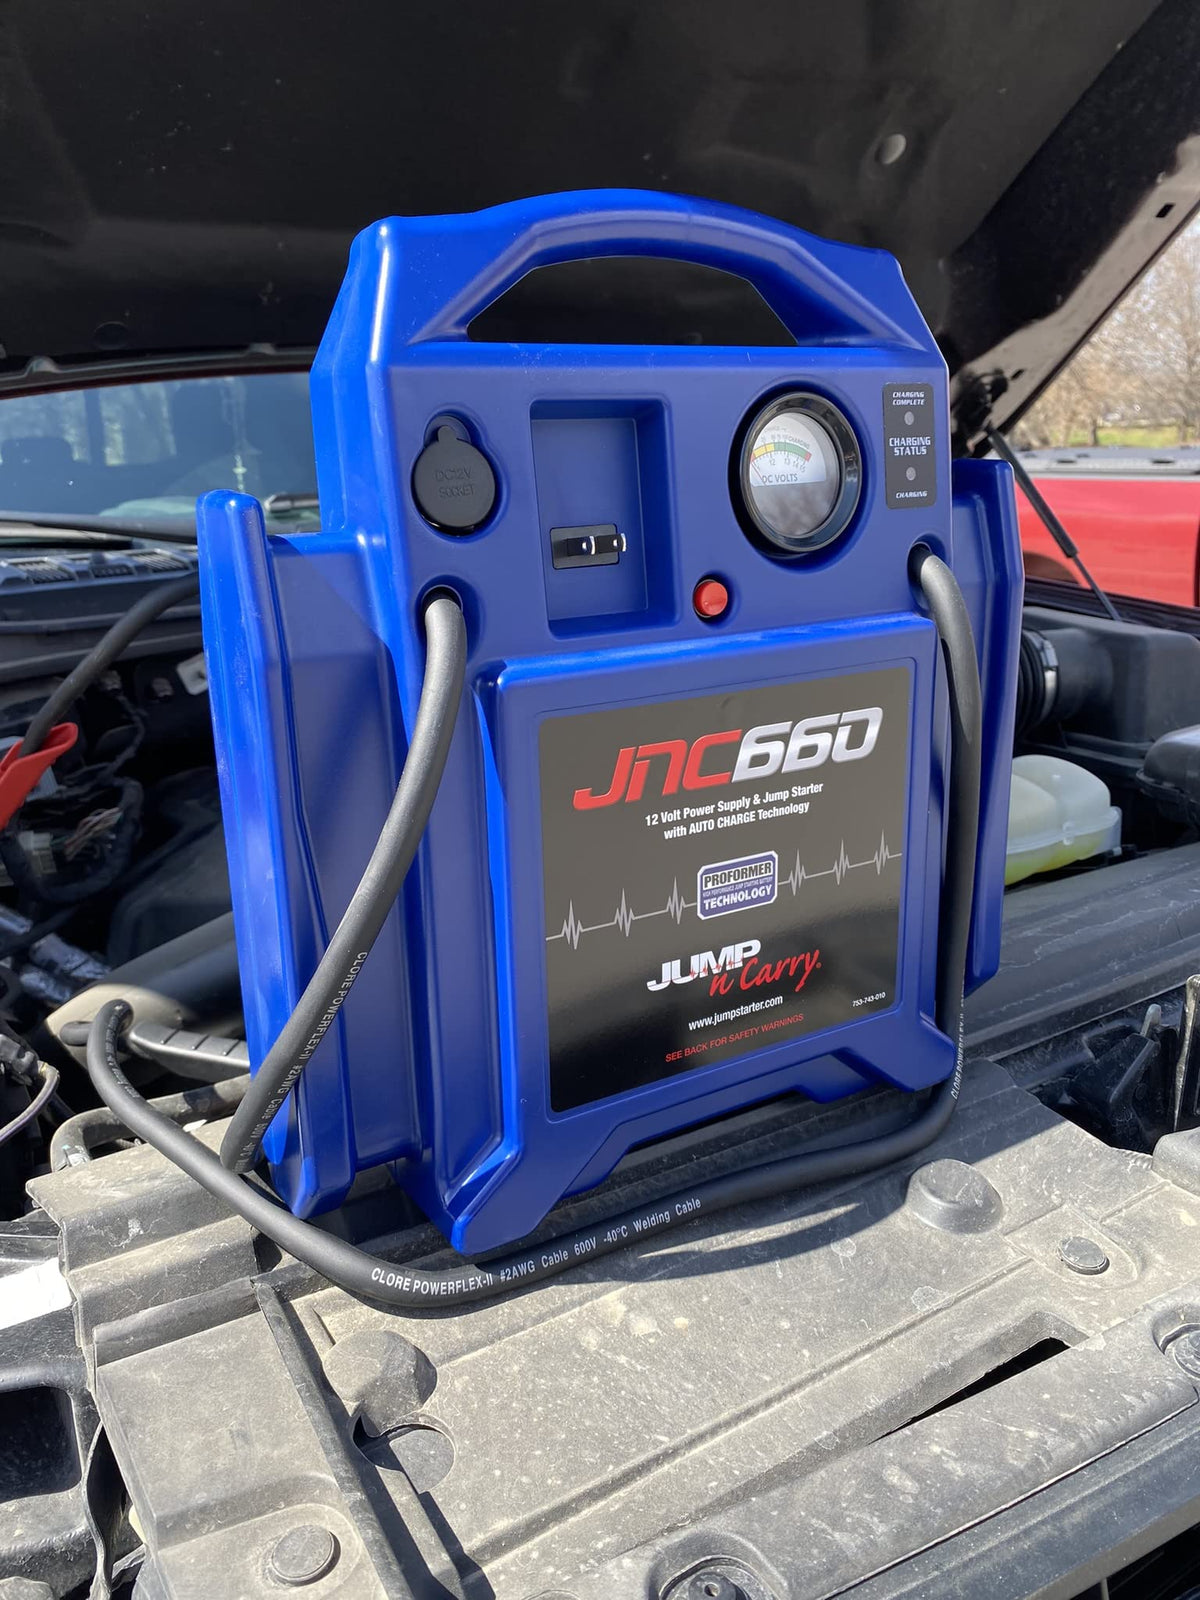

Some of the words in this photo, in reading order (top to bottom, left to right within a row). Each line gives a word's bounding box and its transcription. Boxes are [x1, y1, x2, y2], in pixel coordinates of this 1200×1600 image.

[889, 436, 931, 447] CHARGING
[894, 446, 927, 456] STATUS
[439, 484, 474, 498] SOCKET
[762, 475, 773, 483] DC
[775, 473, 798, 482] VOLTS
[896, 491, 928, 499] CHARGING
[645, 814, 659, 827] 12
[661, 809, 681, 824] Volt
[683, 803, 716, 820] Power
[717, 797, 751, 814] Supply
[753, 794, 761, 805] &
[762, 790, 790, 804] Jump
[791, 783, 823, 796] Starter
[663, 825, 687, 840] with
[688, 818, 715, 835] AUTO
[717, 811, 756, 828] CHARGE
[757, 801, 810, 820] Technology
[704, 862, 772, 889] PROFORMER
[703, 884, 773, 911] TECHNOLOGY
[341, 951, 368, 990] CLORE
[646, 939, 762, 991] JUMP
[709, 973, 735, 997] n
[852, 991, 886, 1007] 753-743-010
[688, 995, 784, 1031] www.jumpstarter.com
[665, 1053, 683, 1063] SEE
[684, 1043, 708, 1057] BACK
[709, 1037, 727, 1049] FOR
[728, 1027, 760, 1043] SAFETY
[761, 1013, 804, 1032] WARNINGS
[371, 1267, 411, 1292] CLORE
[412, 1273, 493, 1296] POWERFLEX-II
[500, 1260, 535, 1283] #2AWG
[541, 1249, 569, 1268] Cable
[574, 1236, 597, 1256] 600V
[633, 1210, 671, 1232] Welding
[675, 1198, 701, 1216] Cable
